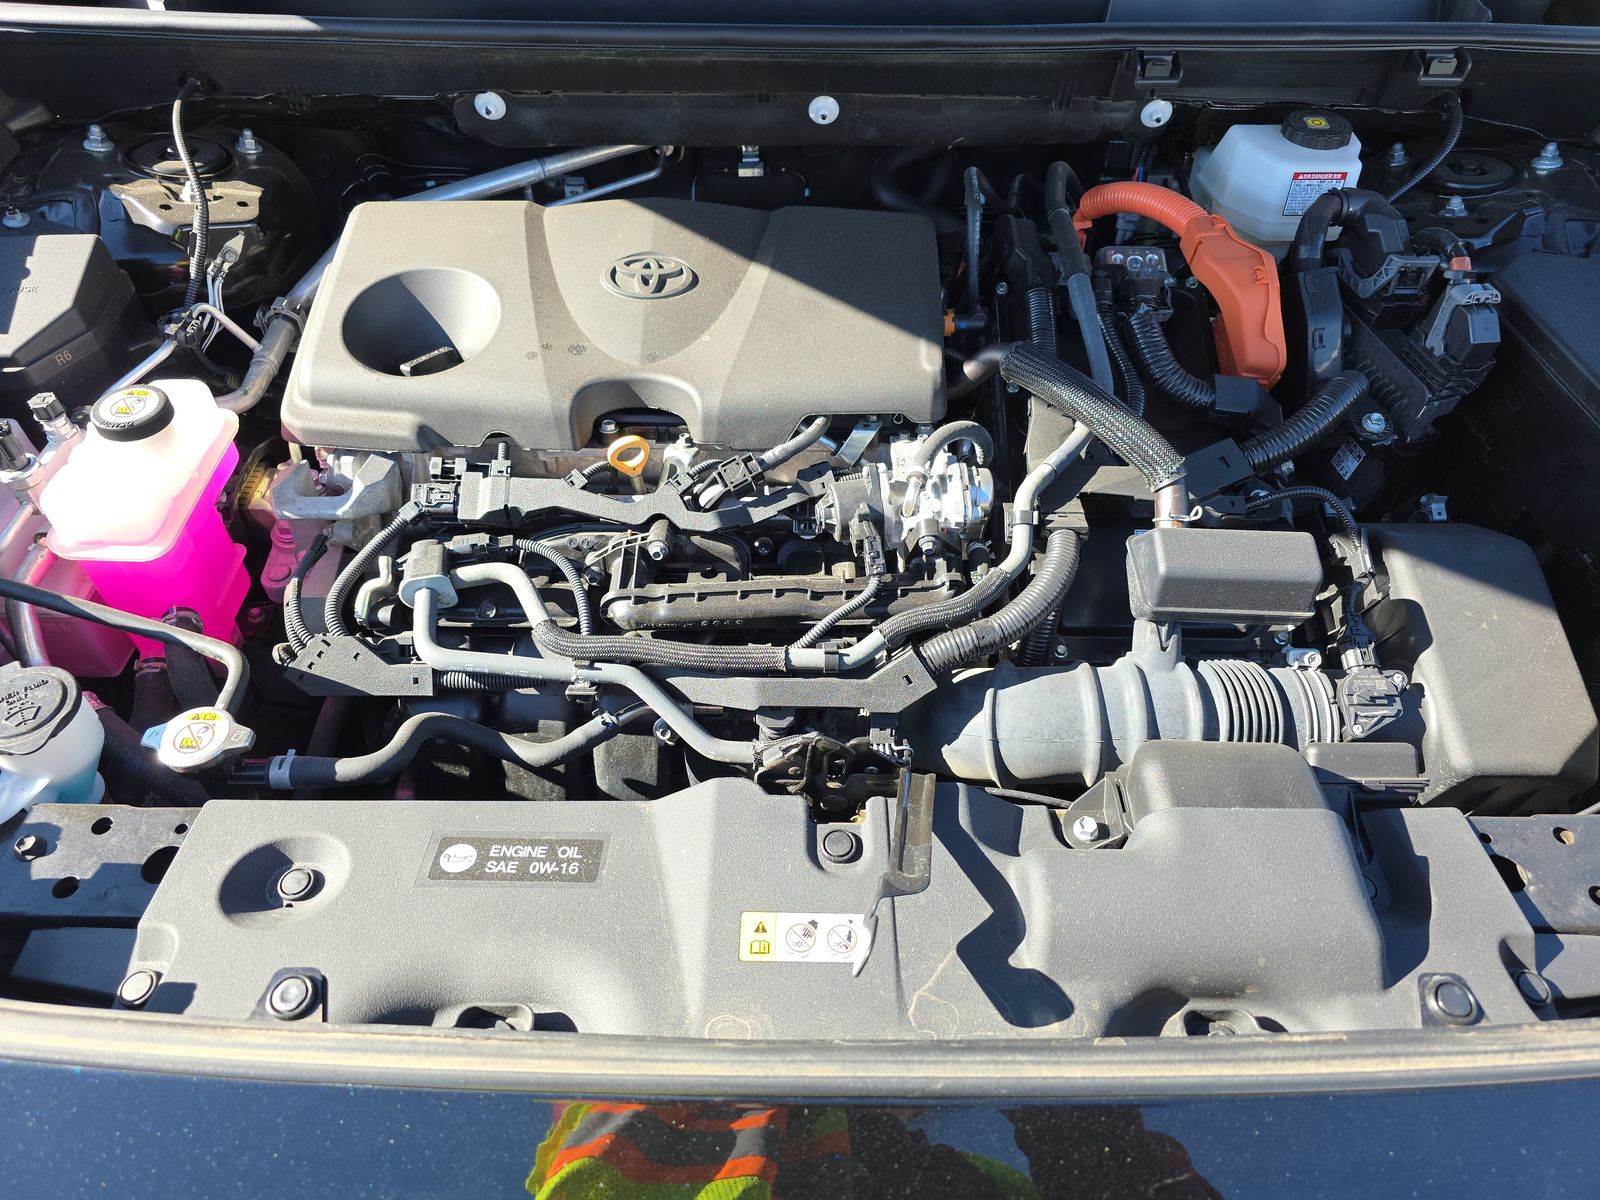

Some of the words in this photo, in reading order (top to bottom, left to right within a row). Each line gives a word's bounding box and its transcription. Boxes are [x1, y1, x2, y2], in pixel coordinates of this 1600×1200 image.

[55, 350, 72, 366] R6
[489, 845, 548, 858] ENGINE
[557, 846, 583, 858] OIL
[485, 861, 518, 874] SAE
[529, 861, 579, 874] 0W-16
